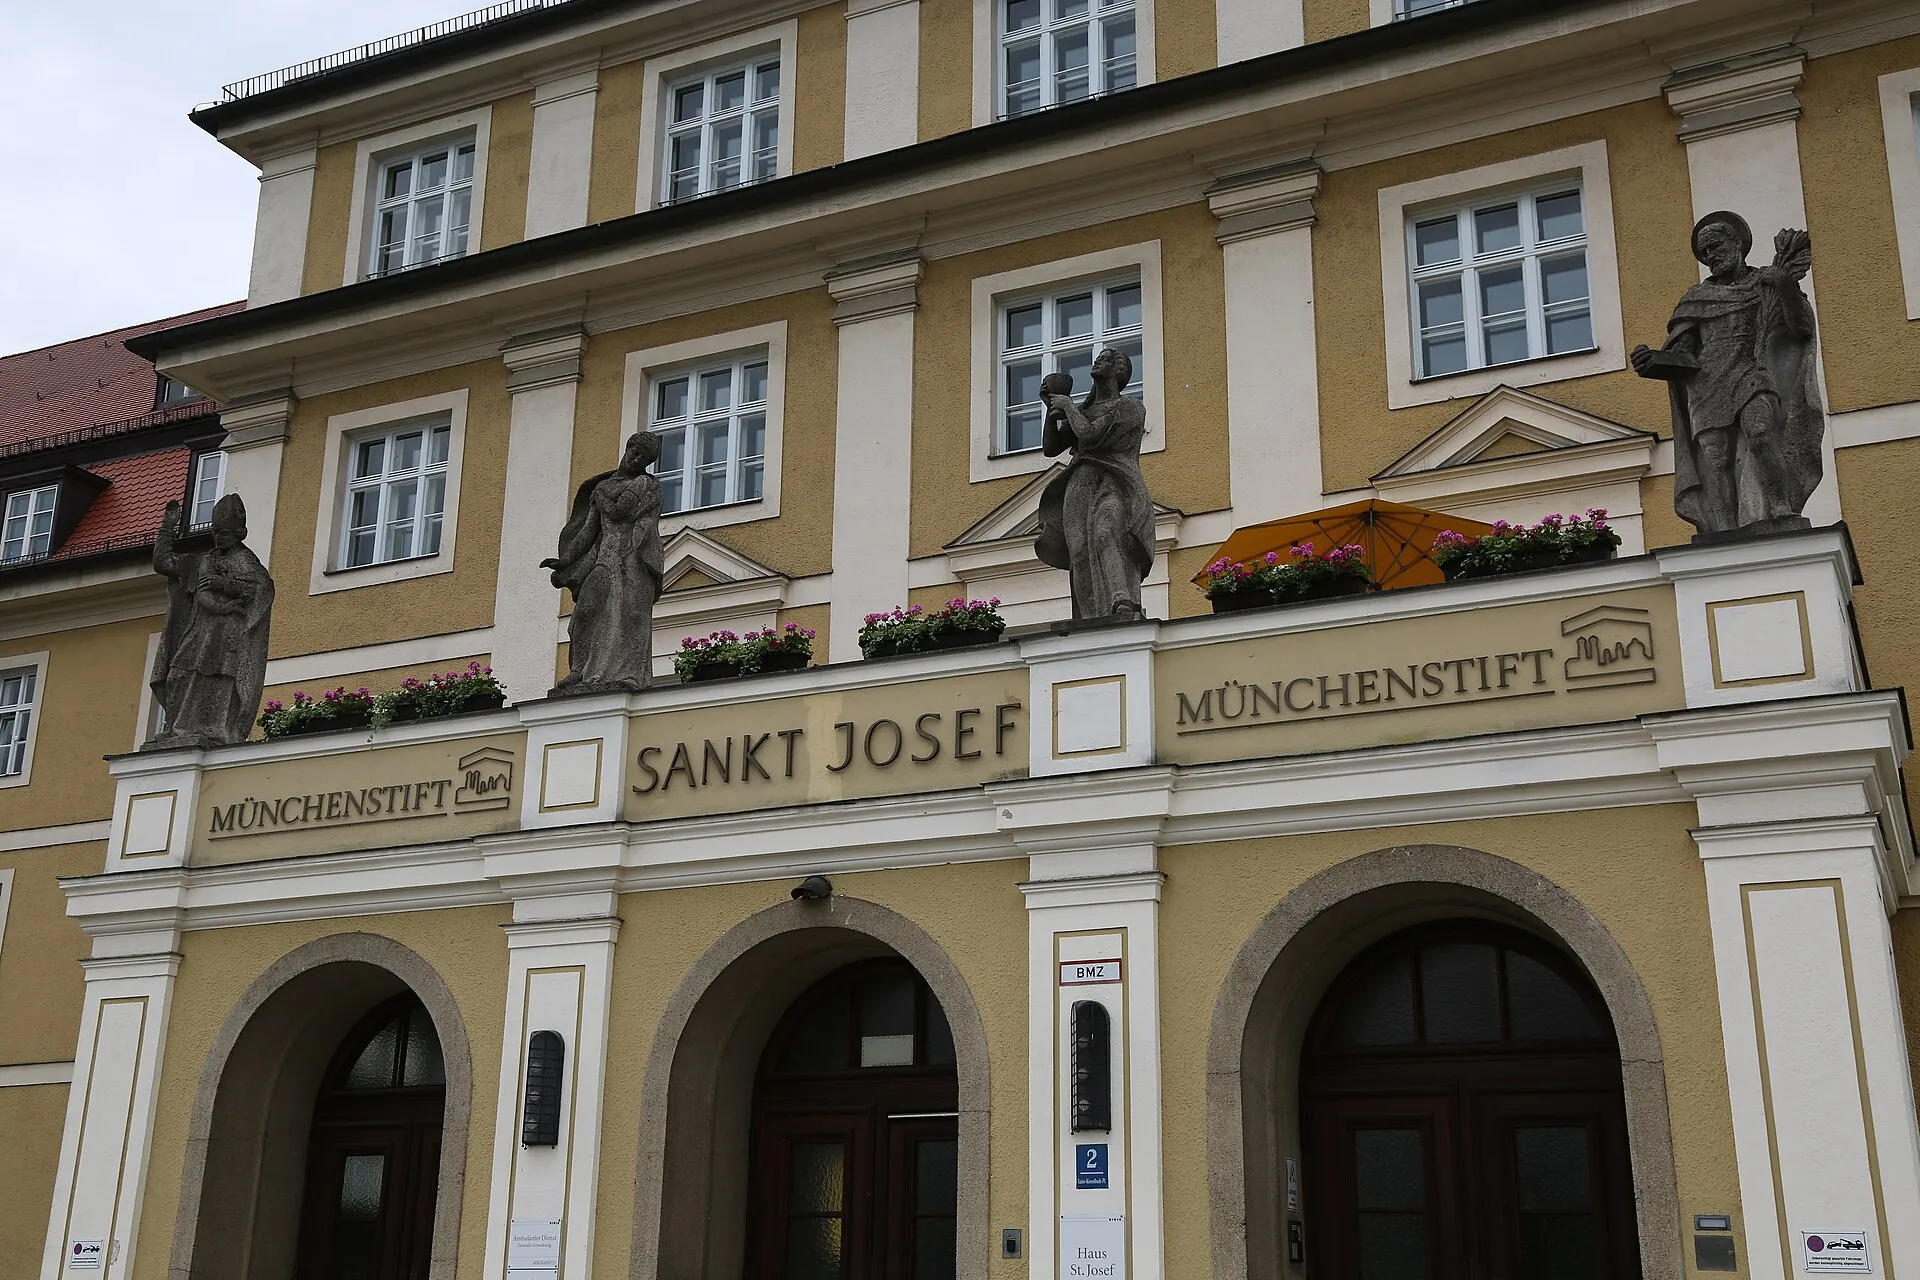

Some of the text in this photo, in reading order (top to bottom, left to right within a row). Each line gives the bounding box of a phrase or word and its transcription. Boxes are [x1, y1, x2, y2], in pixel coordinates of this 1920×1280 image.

[1176, 648, 1554, 725] MÜNCHENSTIFT
[632, 702, 1022, 794] SANKT JOSEF
[209, 779, 452, 834] MÜNCHENSTIFT
[1077, 966, 1104, 978] BMZ
[1086, 1148, 1097, 1169] 2
[1077, 1247, 1107, 1260] Haus
[1086, 1263, 1116, 1278] Josef
